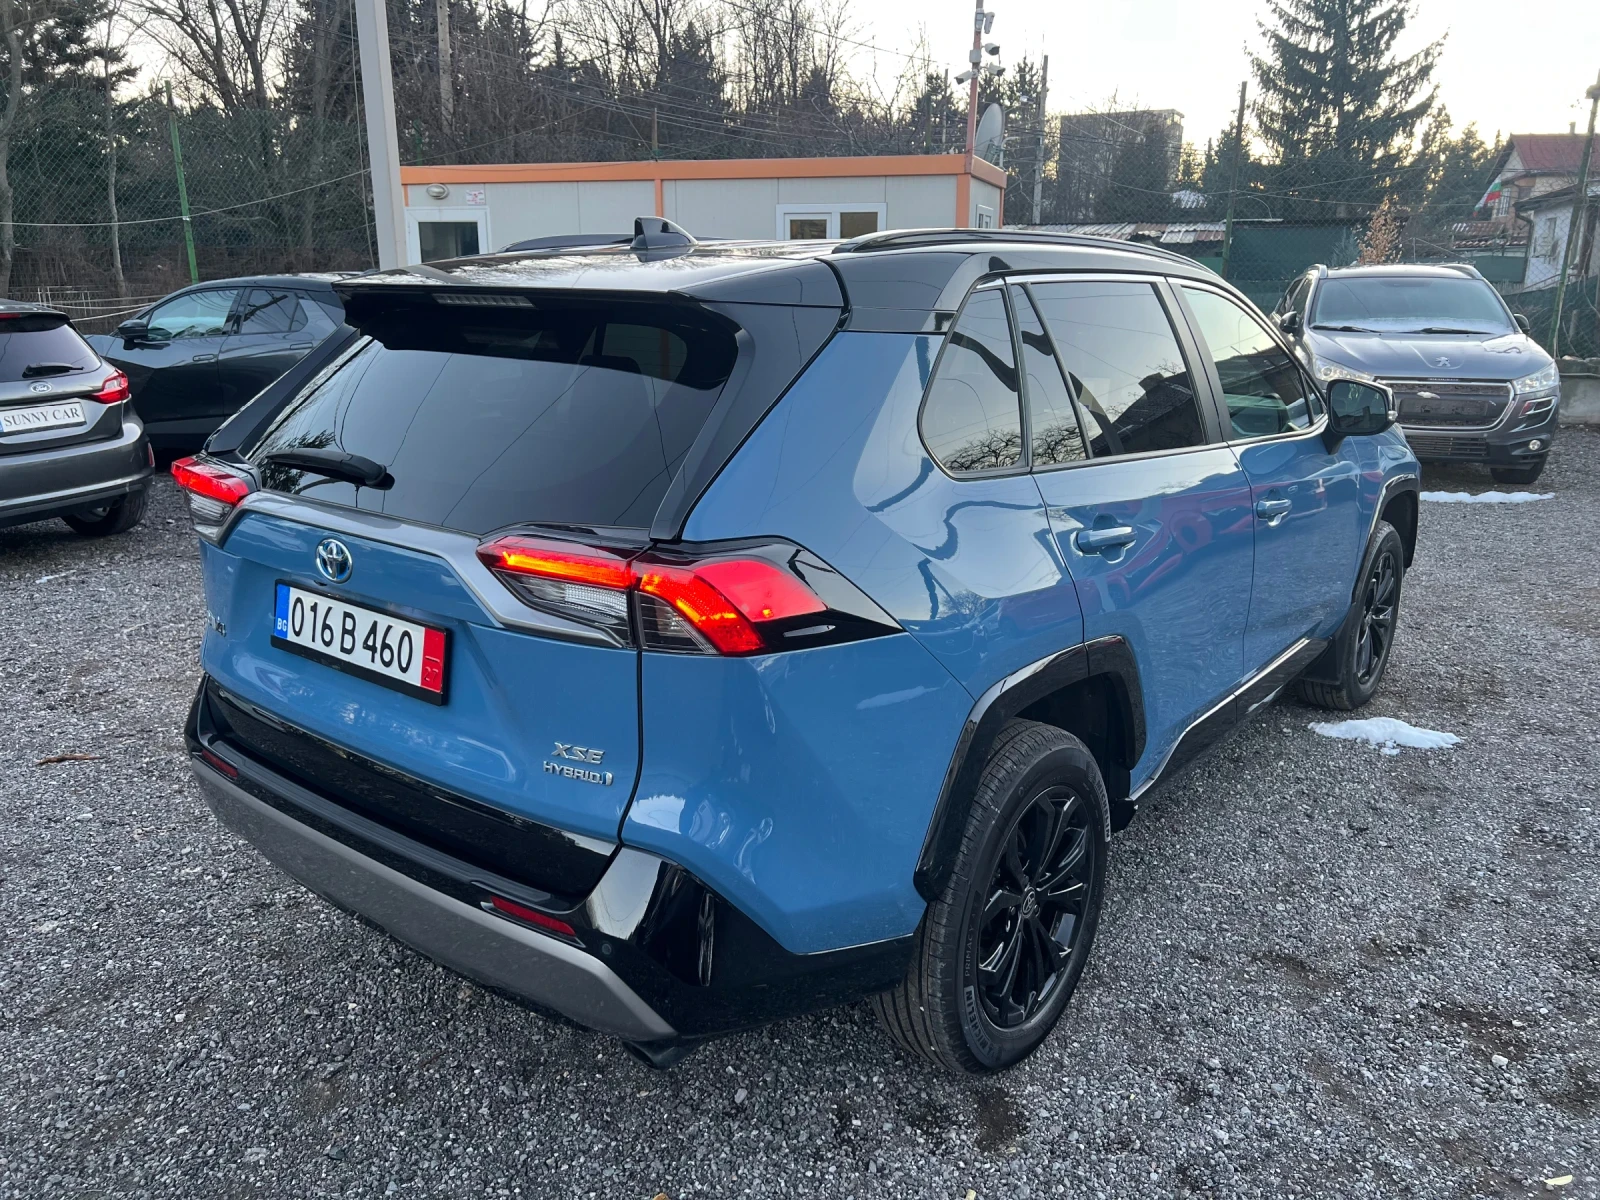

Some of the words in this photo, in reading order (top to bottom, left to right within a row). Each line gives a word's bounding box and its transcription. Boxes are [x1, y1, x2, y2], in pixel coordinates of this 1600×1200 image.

[3, 410, 49, 427] SUNNY
[52, 407, 80, 421] CAR
[277, 617, 288, 632] BG
[424, 666, 439, 683] 27
[551, 741, 605, 765] XSE
[543, 760, 600, 784] HYBRID
[964, 923, 975, 977] PRIMACY
[965, 990, 990, 1049] MICHELIN
